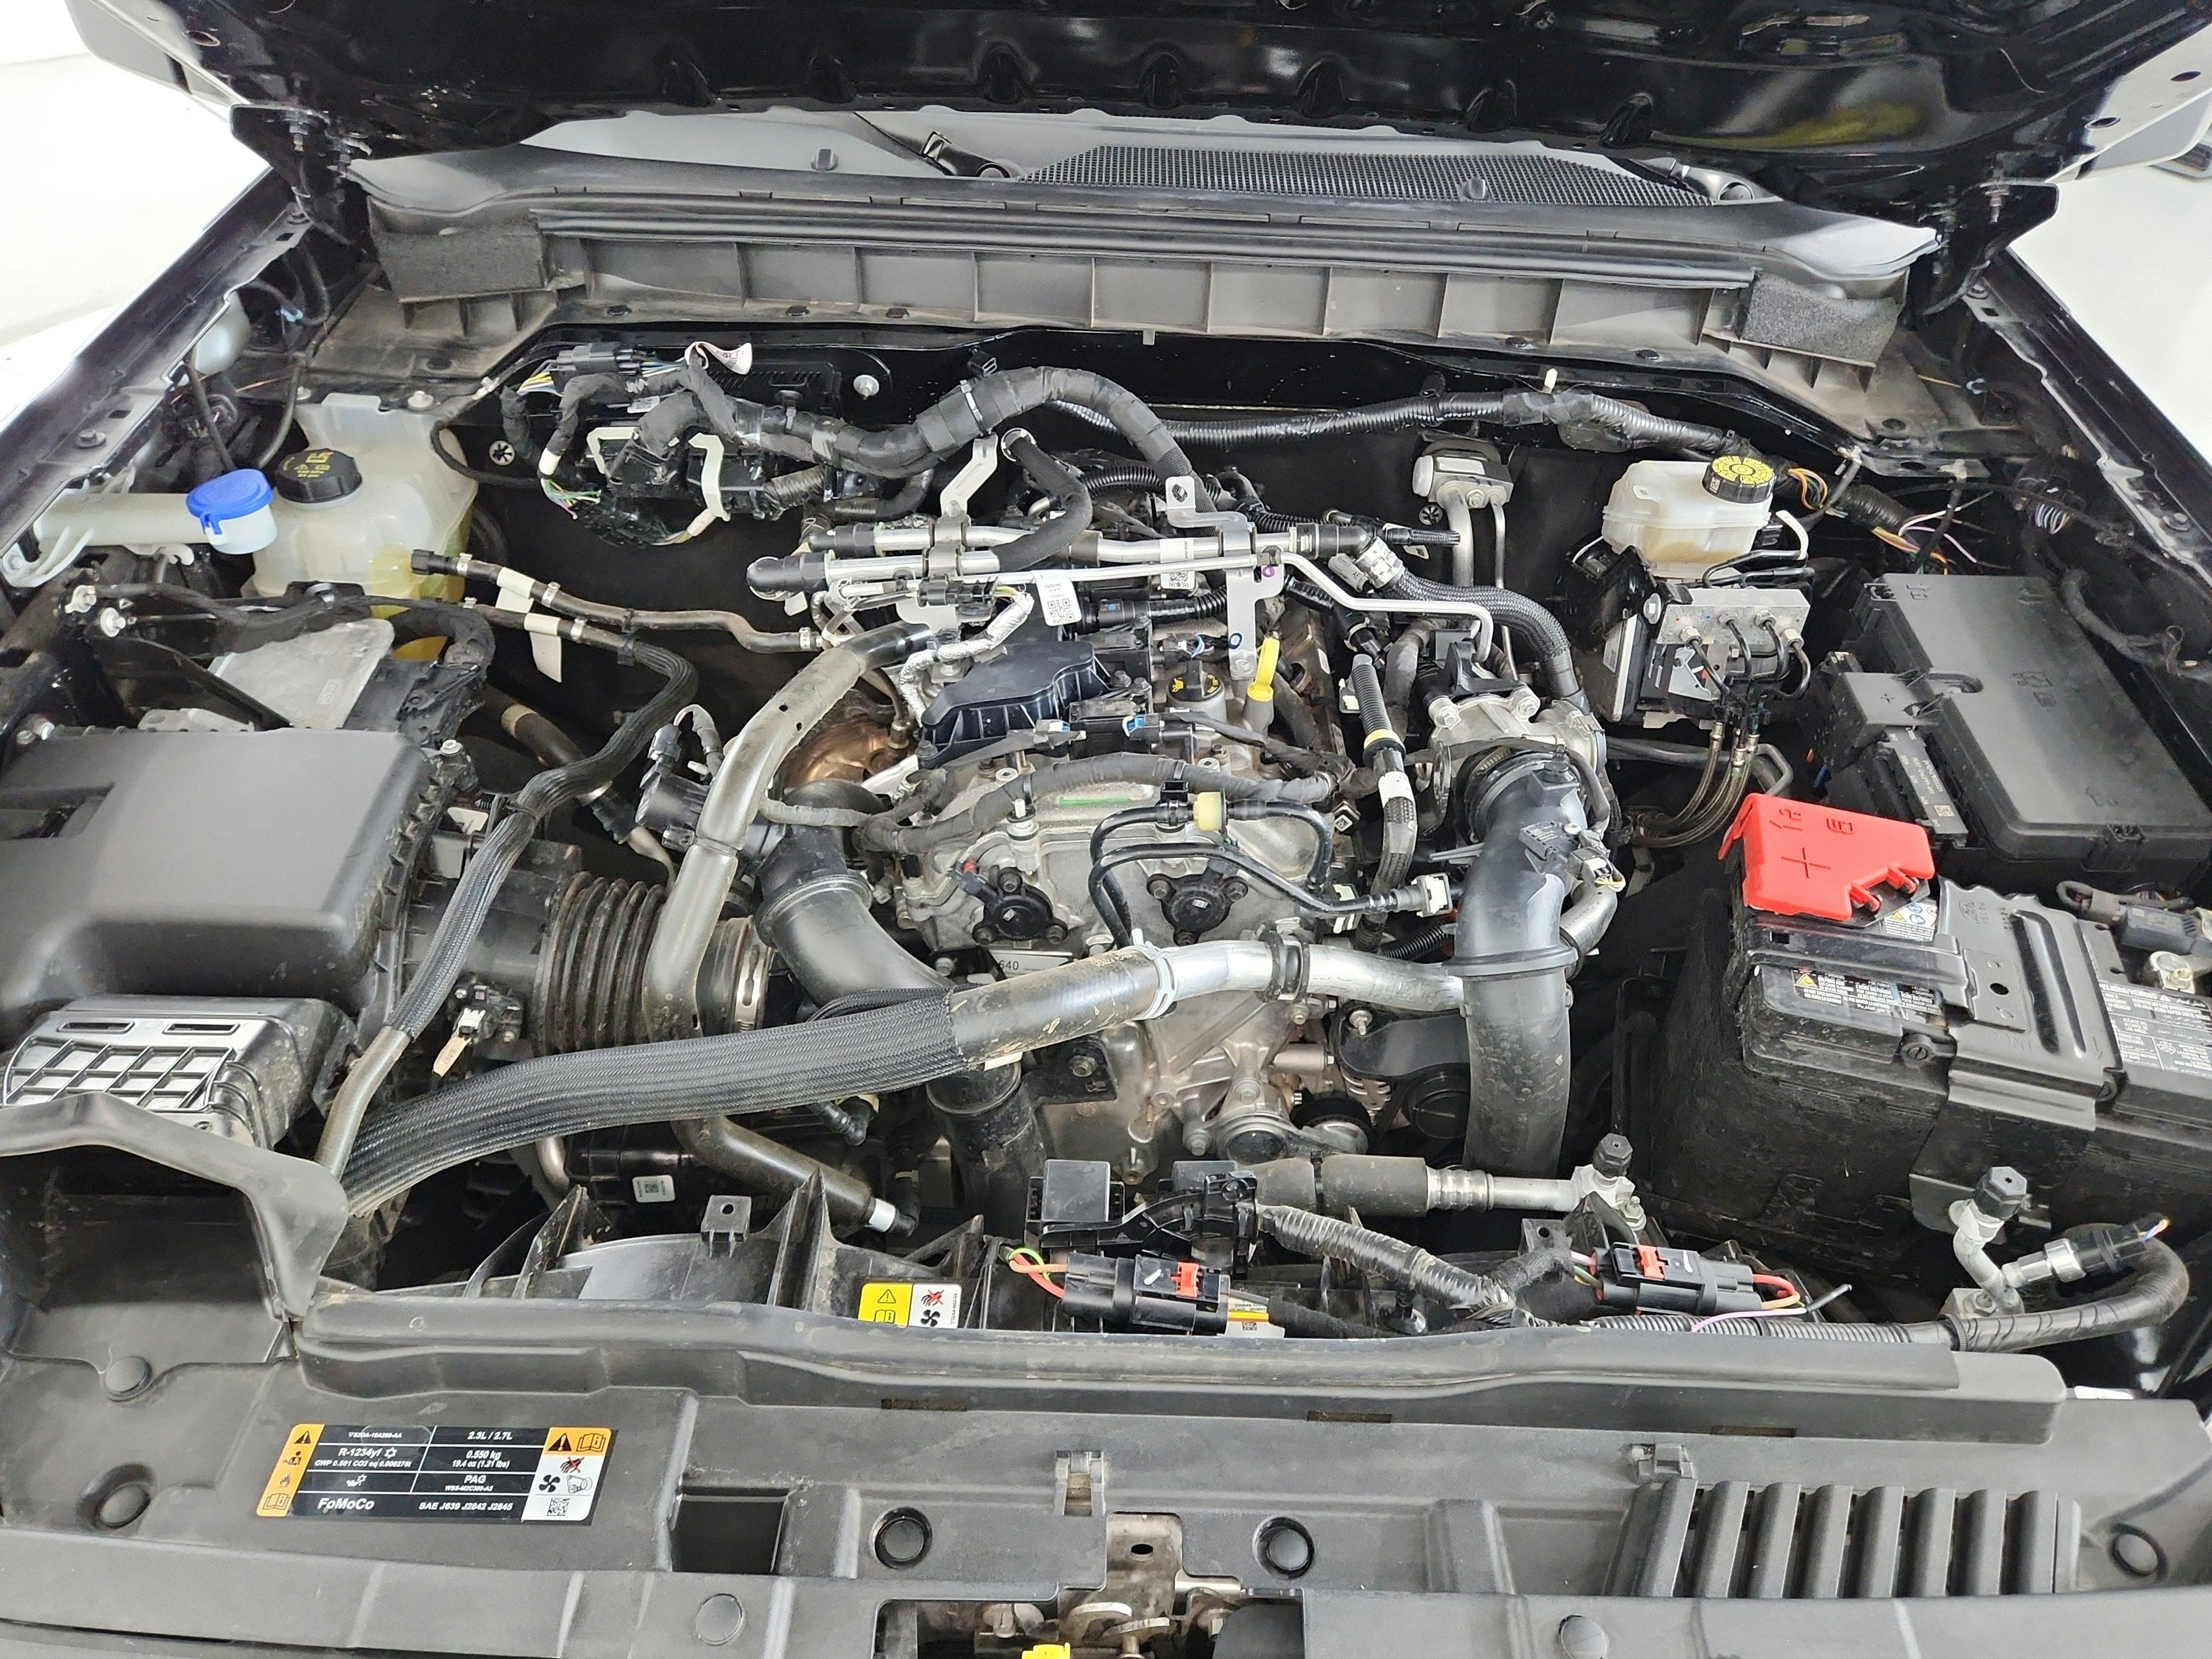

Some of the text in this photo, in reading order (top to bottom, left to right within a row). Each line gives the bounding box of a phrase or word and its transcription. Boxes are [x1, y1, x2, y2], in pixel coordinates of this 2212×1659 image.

[467, 1431, 487, 1440] 2.3L
[493, 1432, 512, 1440] 2.7L
[338, 1448, 383, 1459] R-1234yf
[466, 1450, 502, 1460] 0.550 kg
[452, 1459, 466, 1468] 19.4
[477, 1460, 495, 1469] (1.21
[495, 1460, 510, 1469] lbs)
[464, 1475, 487, 1484] PAG
[317, 1498, 375, 1510] FoMoCo
[419, 1502, 438, 1510] SAE
[461, 1503, 487, 1511] J2842
